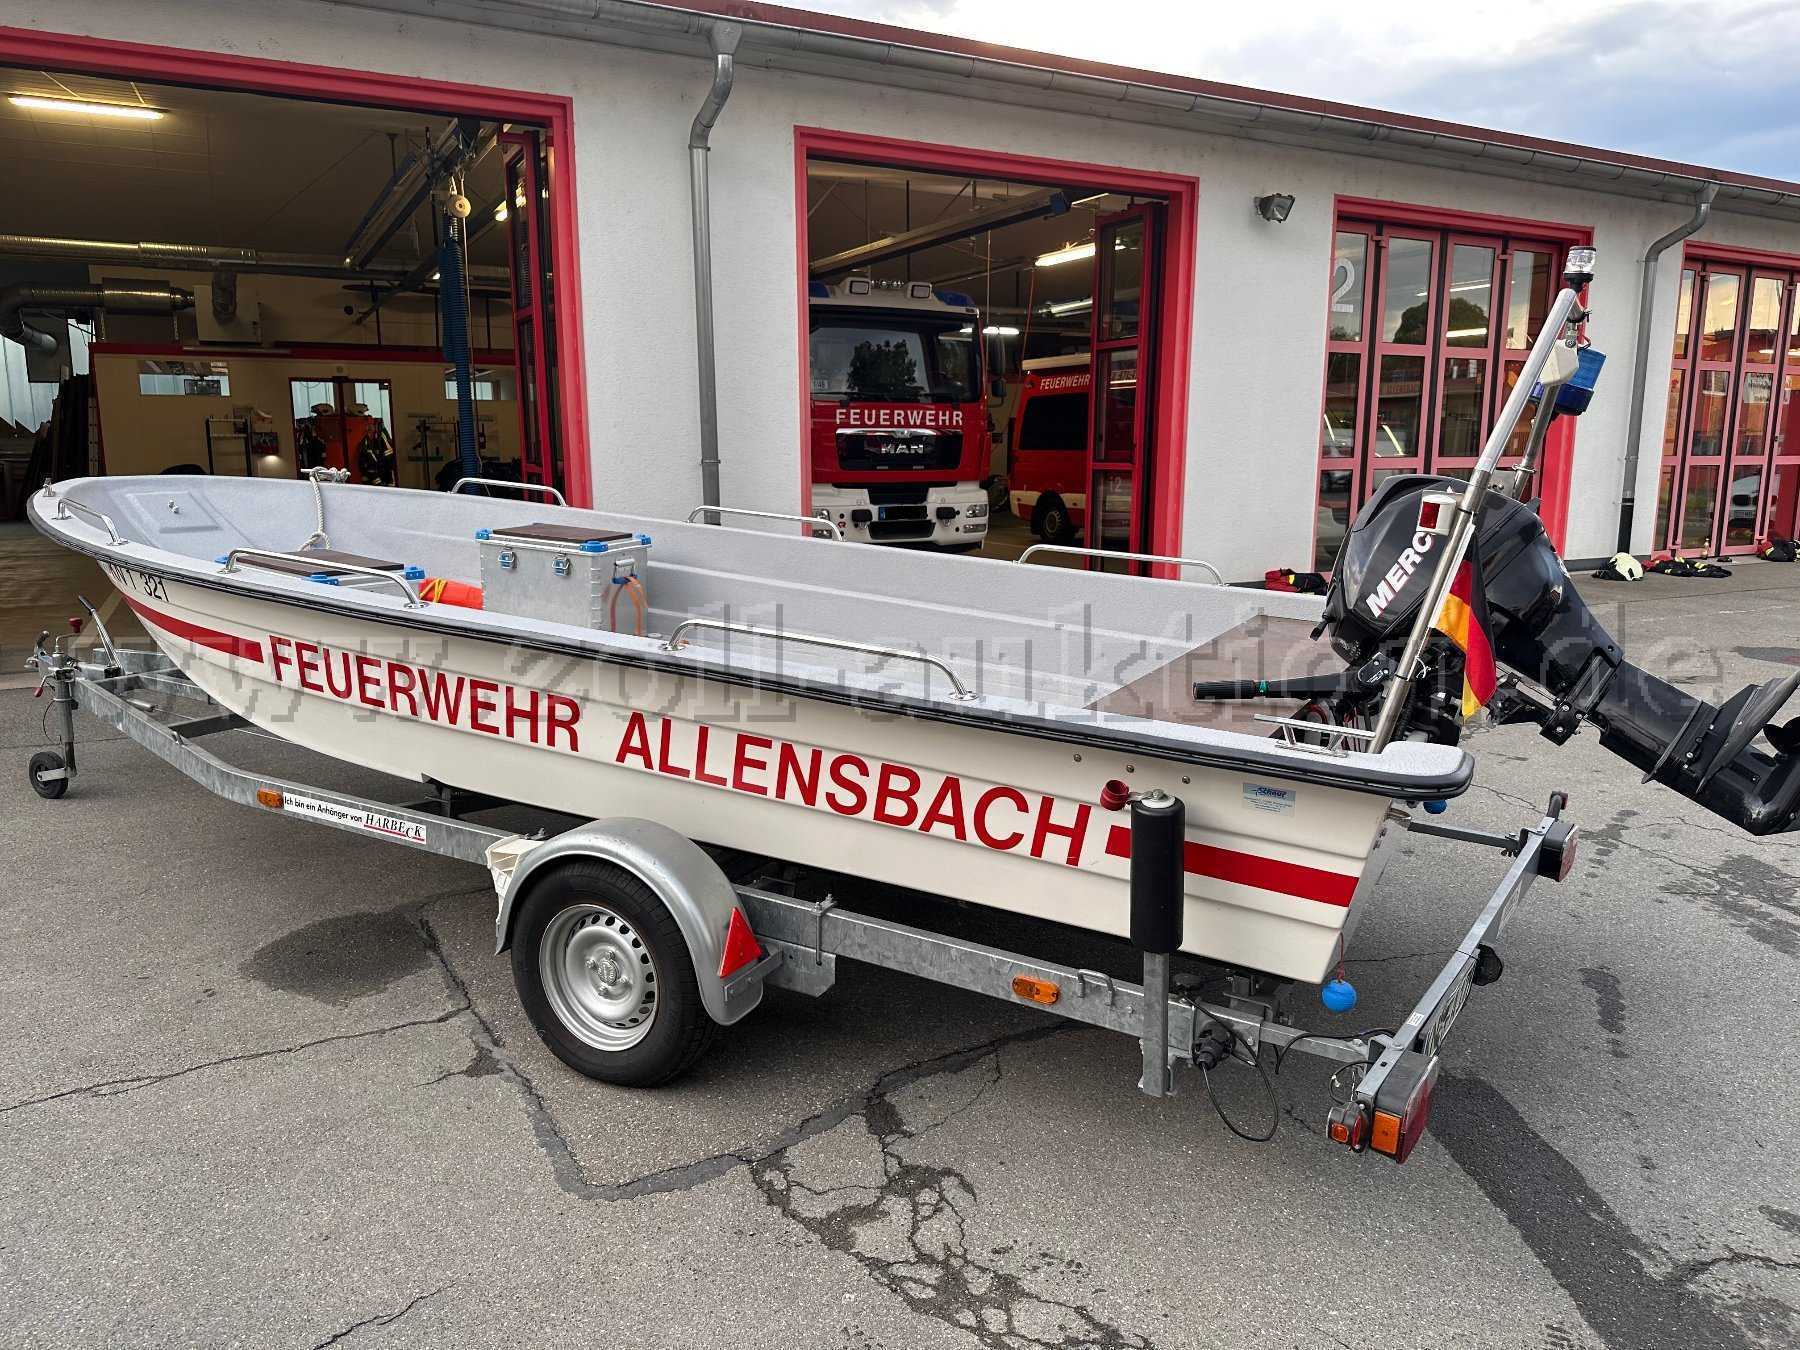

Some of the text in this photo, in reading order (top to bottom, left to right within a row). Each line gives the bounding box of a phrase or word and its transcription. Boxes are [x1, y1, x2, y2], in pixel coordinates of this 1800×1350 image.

[1332, 257, 1355, 313] 2
[1040, 375, 1091, 390] FEUERWEHR
[835, 408, 964, 426] FEUERWEHR
[880, 443, 925, 454] MAN
[140, 573, 169, 602] 321
[1366, 531, 1433, 618] MERC
[268, 634, 1092, 867] FEUERWEHR ALLENSBACH
[284, 795, 294, 806] Ich
[294, 799, 305, 809] bin
[306, 802, 316, 812] ein
[350, 814, 363, 823] von
[365, 813, 425, 839] HARBECK
